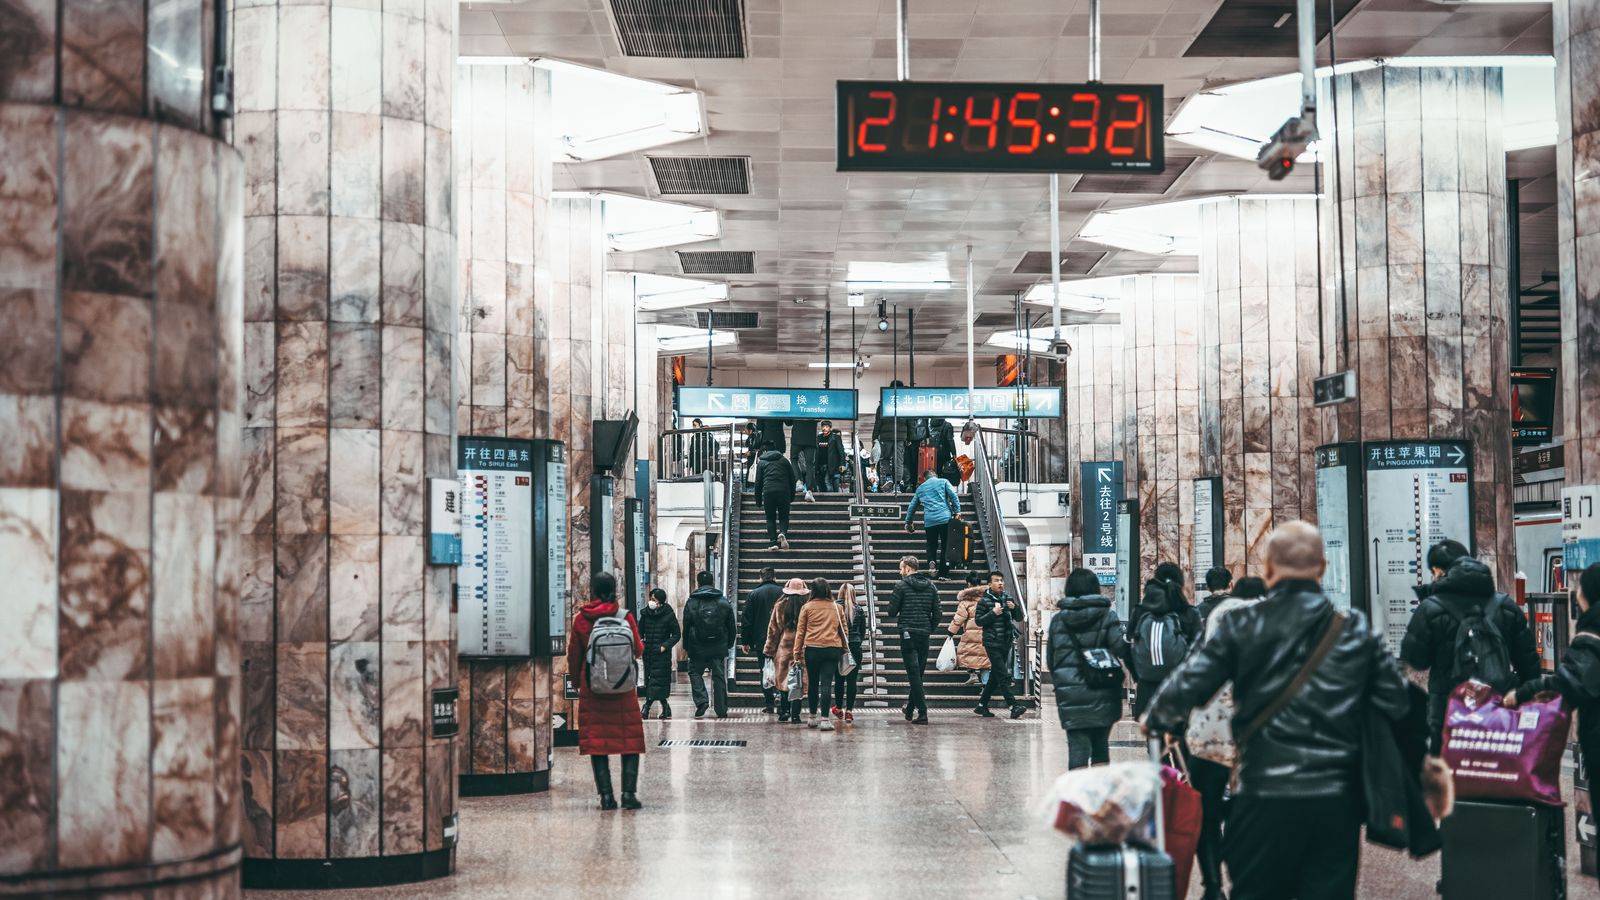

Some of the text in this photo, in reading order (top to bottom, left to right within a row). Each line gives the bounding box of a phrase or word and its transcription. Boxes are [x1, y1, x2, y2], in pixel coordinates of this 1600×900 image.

[857, 90, 1144, 156] 21:45:32
[796, 394, 829, 405] 换乘
[932, 395, 943, 410] B
[799, 405, 827, 413] Transfer
[464, 447, 530, 462] 开往四惠东
[1370, 445, 1441, 460] 开往苹果园
[1385, 459, 1435, 467] PINGGUOYUAN
[1099, 485, 1113, 547] 去往2号线
